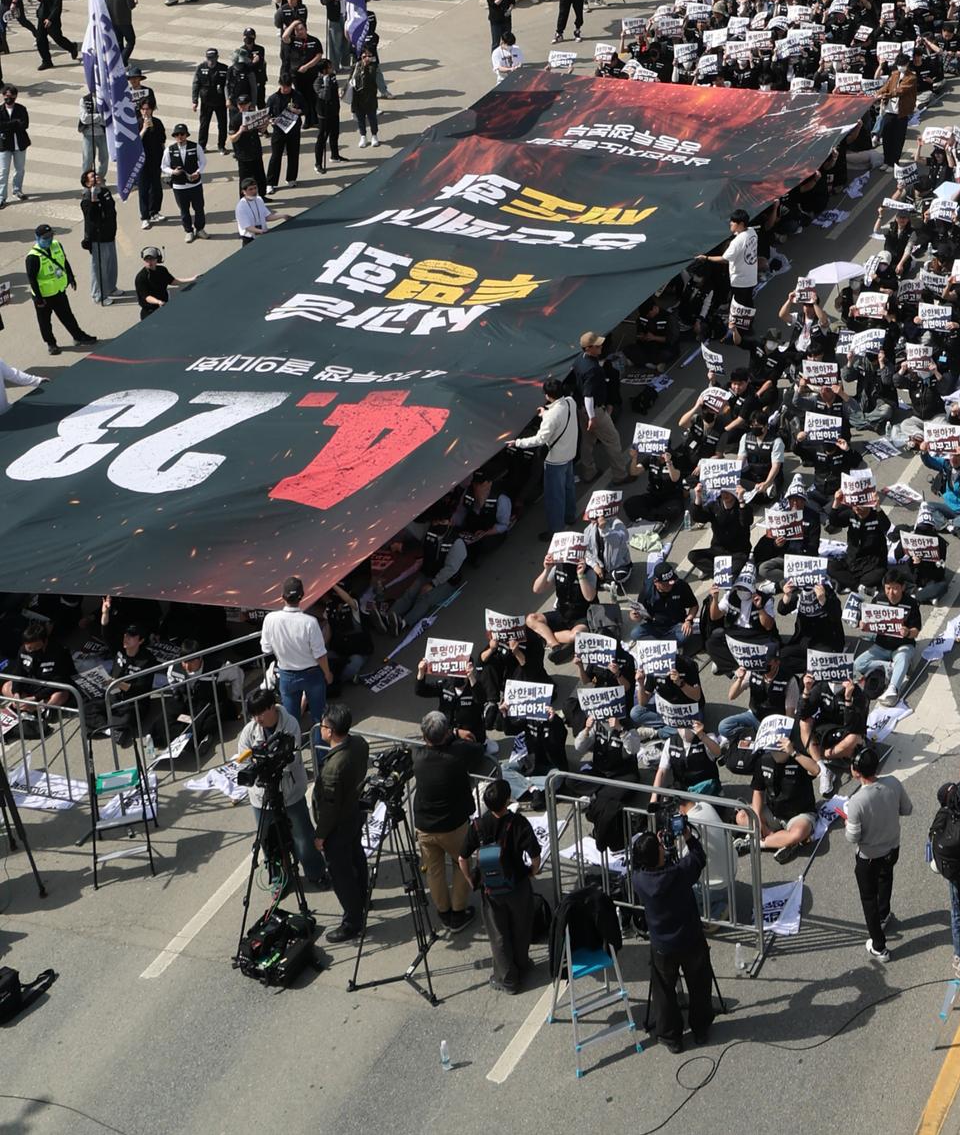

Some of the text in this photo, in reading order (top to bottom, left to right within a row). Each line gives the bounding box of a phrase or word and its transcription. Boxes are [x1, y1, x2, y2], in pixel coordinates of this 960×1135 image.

[564, 124, 702, 155] 공동투쟁본부
[526, 138, 711, 166] 삼성전자노동조합
[315, 242, 545, 305] 투명화
[921, 307, 947, 317] 상한폐지
[185, 354, 316, 376] 결의대회
[806, 363, 835, 375] 투명하게
[807, 416, 837, 427] 상한폐지
[637, 429, 666, 440] 상한폐지
[808, 430, 840, 441] 실현하자
[926, 427, 956, 438] 투명하게
[6, 389, 451, 510] 4.23
[638, 442, 667, 453] 실현하자
[928, 440, 960, 453] 바꾸고!!!
[702, 462, 737, 475] 상한폐지
[704, 475, 739, 488] 실현하자
[843, 478, 872, 491] 투명하게
[768, 512, 799, 524] 투명하게
[771, 526, 803, 540] 바꾸고!!!
[903, 535, 935, 548] 투명하게
[787, 560, 821, 573] 상한폐지
[789, 574, 825, 586] 실현하자
[865, 608, 899, 619] 투명하게
[488, 615, 521, 628] 투명하게
[869, 622, 904, 634] 바꾸고!!!
[491, 630, 525, 642] 바꾸고!!!
[430, 644, 467, 656] 투명하게
[577, 637, 612, 650] 상한폐지
[580, 651, 614, 665] 실현하자
[638, 645, 671, 658] 상한폐지
[431, 661, 468, 673] 바꾸고!!!
[810, 655, 848, 667] 상한폐지
[812, 668, 853, 681] 실현하자
[507, 686, 547, 699] 상한폐지
[580, 689, 620, 706] 상한폐지
[509, 702, 549, 716] 실현하자
